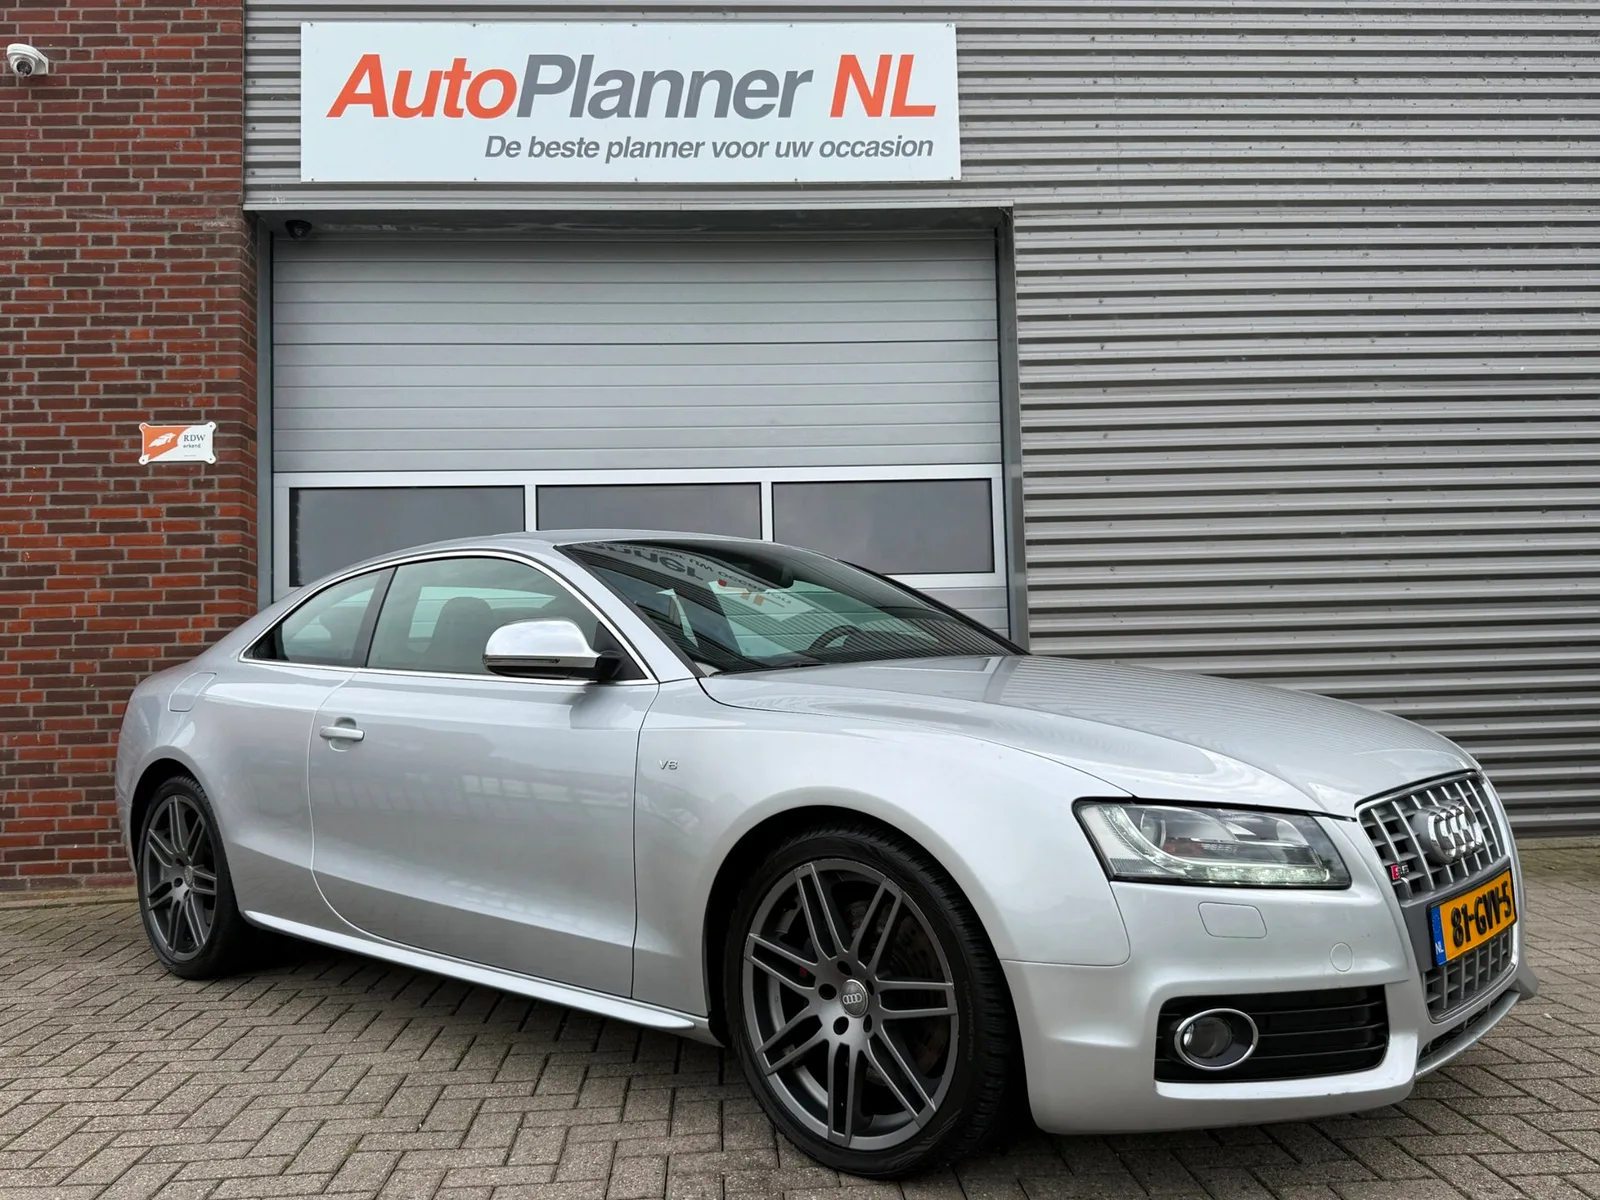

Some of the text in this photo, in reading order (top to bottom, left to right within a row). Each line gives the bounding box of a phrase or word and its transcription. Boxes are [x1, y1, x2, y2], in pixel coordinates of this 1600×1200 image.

[326, 54, 936, 119] AutoPlanner NL
[485, 135, 933, 164] De beste planner voor uw occasion
[183, 434, 206, 442] RDW
[1435, 941, 1445, 955] NL
